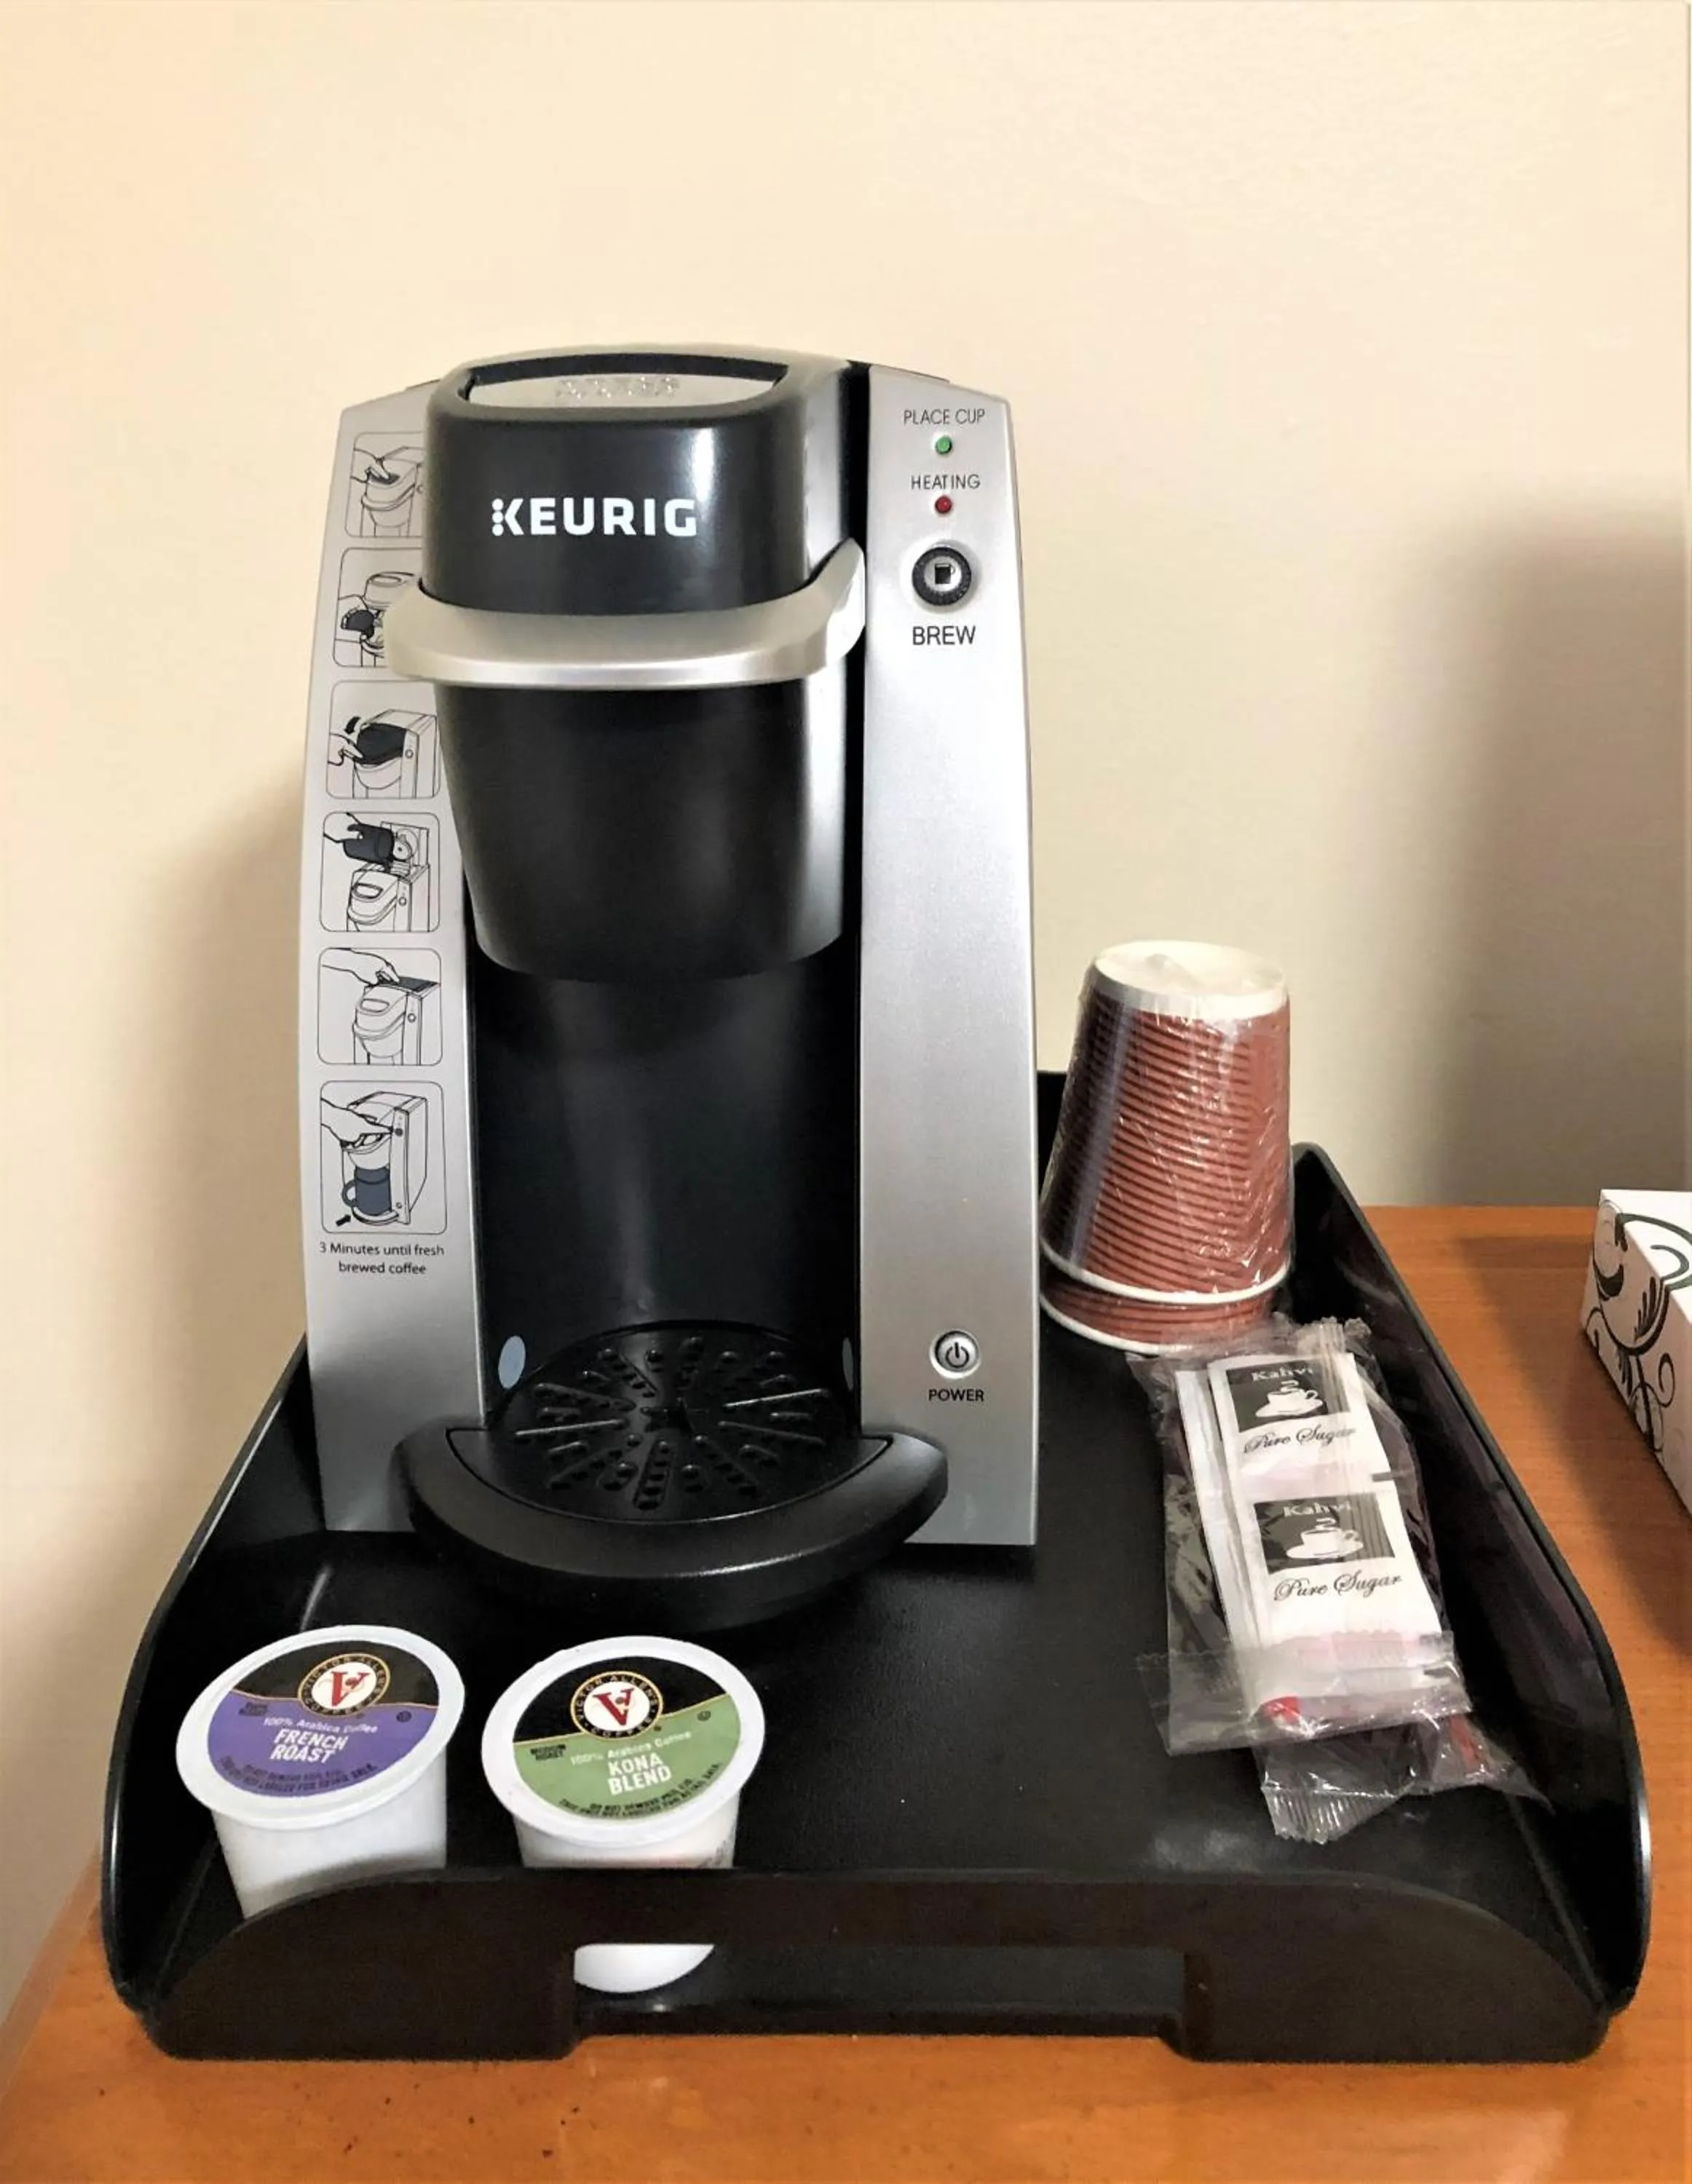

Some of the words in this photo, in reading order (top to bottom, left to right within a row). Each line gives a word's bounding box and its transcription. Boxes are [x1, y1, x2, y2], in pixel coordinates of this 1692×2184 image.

[903, 408, 950, 425] PLACE
[954, 408, 985, 424] CUP
[911, 474, 981, 491] HEATING
[491, 497, 697, 537] KEURIG
[912, 625, 976, 646] BREW
[320, 1241, 327, 1253] 3
[330, 1243, 380, 1255] Minutes
[384, 1243, 411, 1256] until
[414, 1244, 445, 1256] fresh
[339, 1261, 385, 1273] brewed
[389, 1262, 427, 1275] coffee
[928, 1388, 985, 1401] POWER
[1244, 1432, 1292, 1454] Pure
[1296, 1425, 1356, 1446] Sugar
[1284, 1500, 1351, 1517] Kahvi
[1274, 1578, 1329, 1601] Pure
[1333, 1570, 1402, 1598] Sugar
[274, 1728, 349, 1751] FRENCH
[269, 1744, 336, 1764] ROAST
[607, 1752, 664, 1777] KONA
[607, 1765, 672, 1796] BLEND
